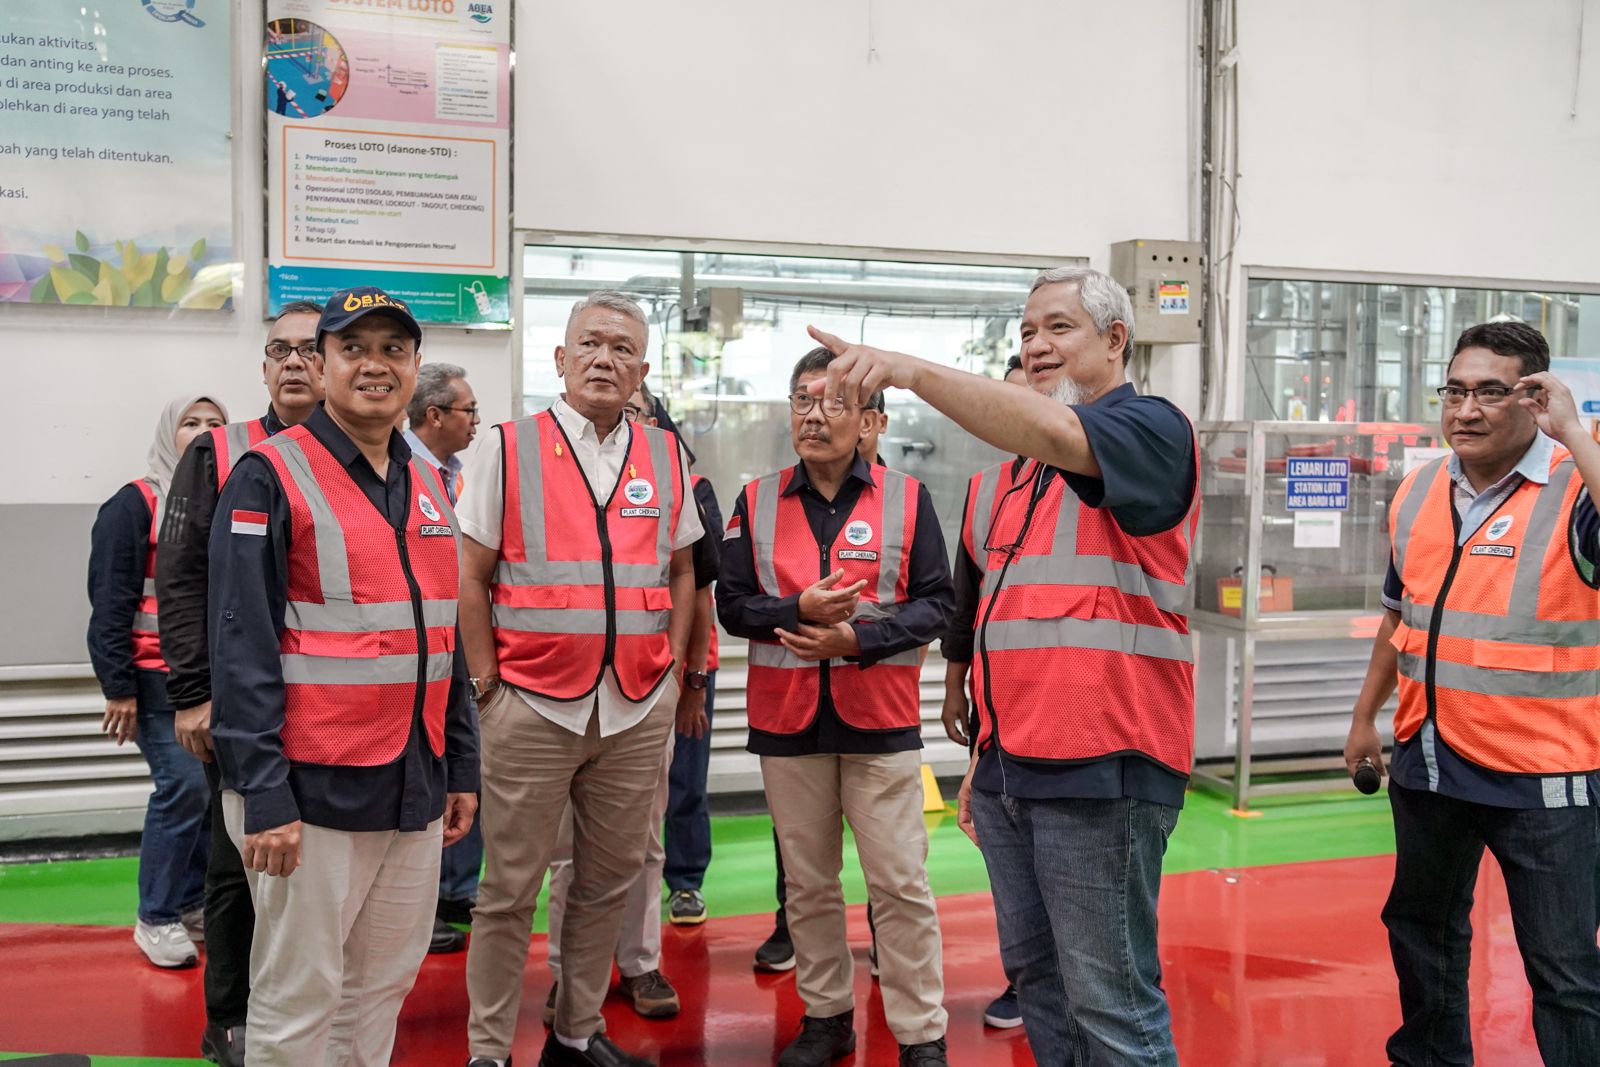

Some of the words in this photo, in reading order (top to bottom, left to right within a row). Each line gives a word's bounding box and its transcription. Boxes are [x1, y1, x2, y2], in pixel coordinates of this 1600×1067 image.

[0, 33, 34, 45] ukan
[39, 36, 97, 51] aktivitas.
[1, 55, 26, 67] dan
[31, 59, 73, 73] anting
[78, 60, 92, 72] ke
[97, 64, 124, 75] area
[128, 66, 173, 78] proses.
[6, 77, 18, 88] di
[23, 80, 50, 91] area
[56, 82, 112, 95] produksi
[117, 85, 140, 97] dan
[145, 89, 172, 99] area
[54, 103, 66, 114] di
[70, 105, 97, 116] area
[102, 108, 133, 121] yang
[138, 108, 169, 120] telah
[25, 147, 57, 159] yang
[63, 147, 94, 159] telah
[99, 148, 173, 164] ditentukan.
[325, 140, 356, 150] Proses
[360, 143, 384, 152] LOTO
[387, 144, 451, 158] (danone-STD)
[0, 187, 28, 199] kasi.
[306, 185, 345, 194] Operasional
[1291, 462, 1323, 476] LEMARI
[1325, 462, 1346, 476] LOTO
[1294, 482, 1323, 494] STATION
[1324, 482, 1342, 494] LOTO
[1288, 495, 1307, 506] AREA
